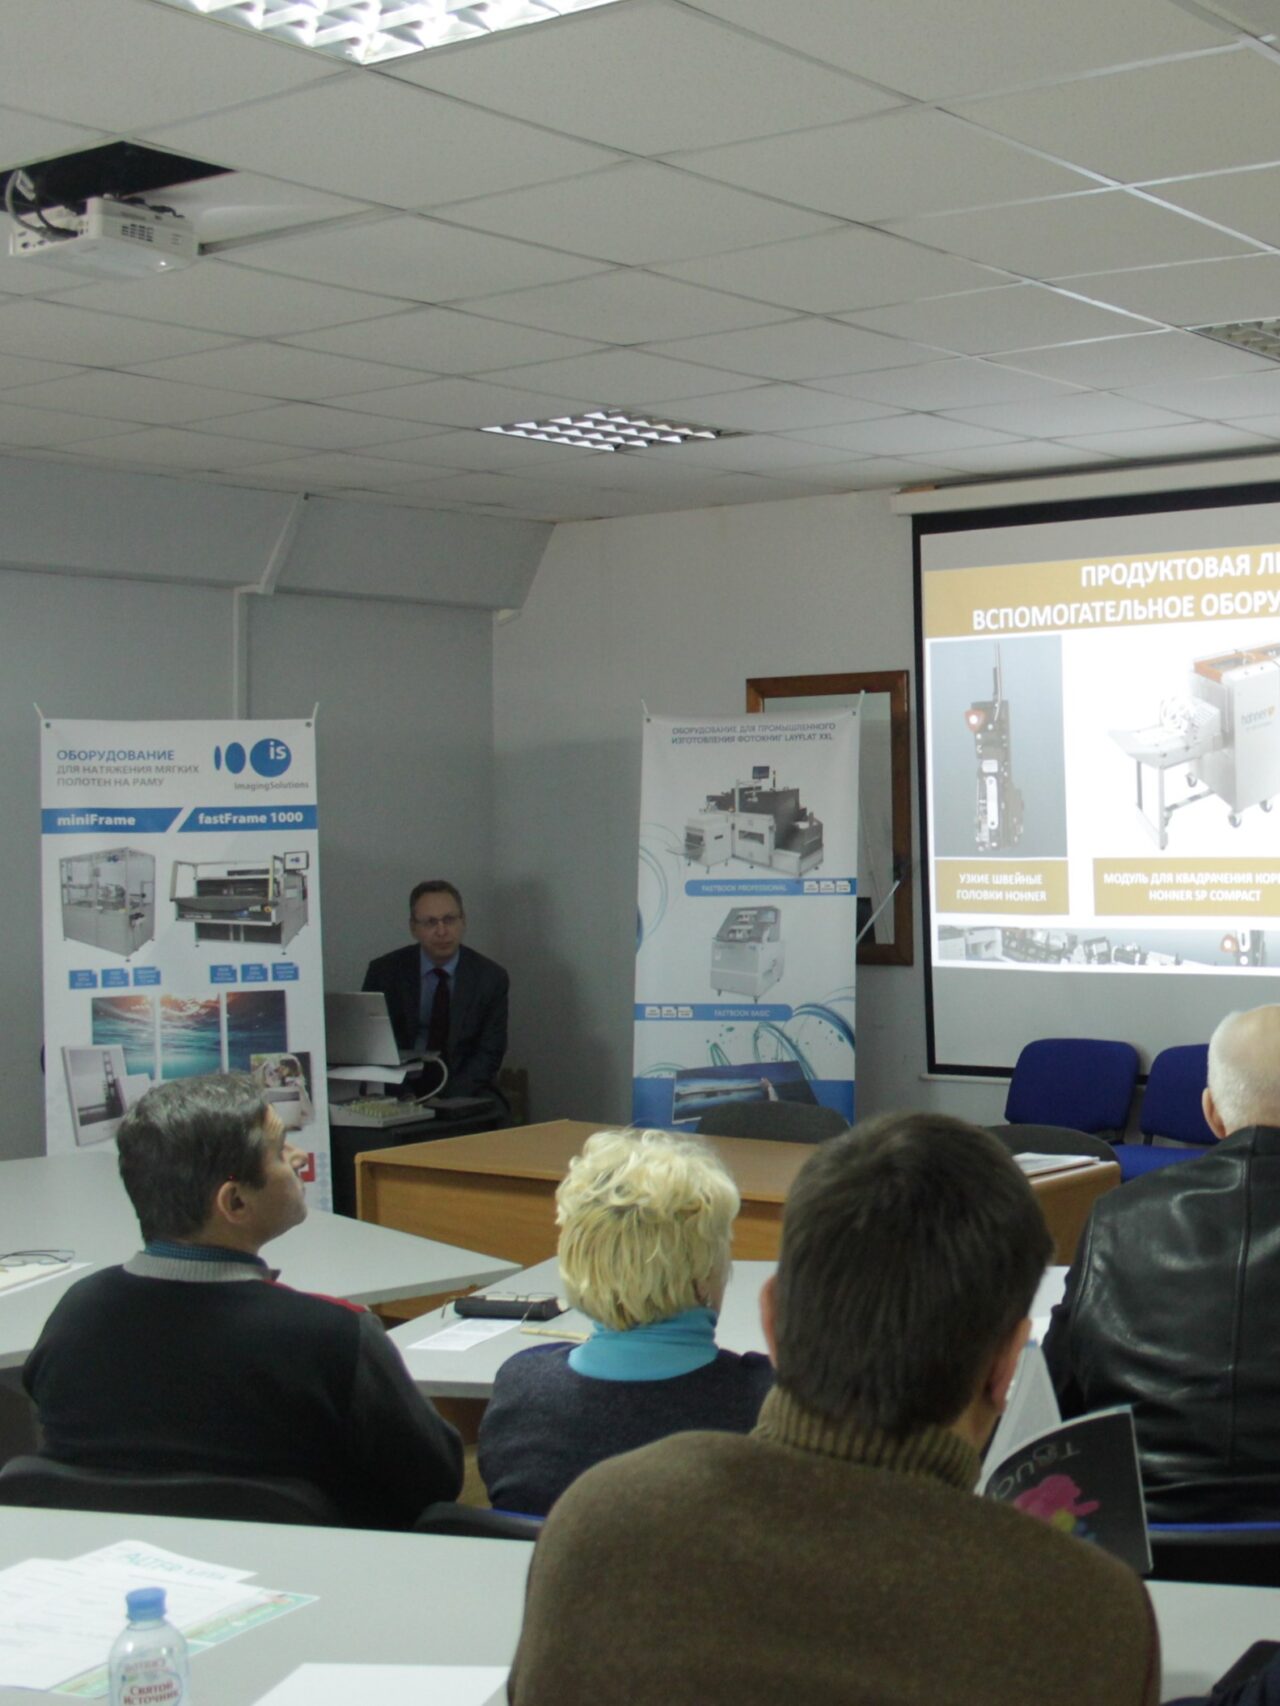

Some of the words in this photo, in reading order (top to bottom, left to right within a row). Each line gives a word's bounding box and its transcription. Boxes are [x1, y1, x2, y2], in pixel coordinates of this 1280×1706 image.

[1081, 554, 1251, 588] ПРОДУКТОВАЯ
[972, 595, 1195, 630] ВСПОМОГАТЕЛЬНОЕ
[672, 726, 737, 736] ОБОРУДОВАНИЕ
[740, 725, 756, 734] ДЛЯ
[758, 722, 836, 732] ПРОМЫШЛЕННОГО
[672, 735, 735, 745] ИЗГОТОВЛЕНИЯ
[57, 749, 175, 763] ОБОРУДОВАНИЕ
[56, 765, 80, 776] ДЛЯ
[82, 765, 153, 775] НАТЯЖЕНИЯ
[155, 764, 199, 774] МЯГКИХ
[57, 778, 111, 788] ПОЛОТЕН
[114, 778, 131, 787] НА
[134, 777, 165, 787] РАМУ
[57, 814, 136, 826] miniFrame
[198, 813, 267, 825] fastFrame
[270, 812, 303, 823] 1000
[959, 873, 989, 884] УЗКИЕ
[992, 872, 1042, 885] ШВЕЙНЫЕ
[1104, 873, 1149, 886] МОДУЛЬ
[1151, 873, 1174, 886] ДЛЯ
[1176, 873, 1252, 886] КВАДРАЧЕНИЯ
[956, 889, 1002, 901] ГОЛОВКИ
[1005, 890, 1046, 902] HOHNER
[1149, 889, 1193, 901] HOHNER
[1209, 890, 1262, 901] COMPACT
[992, 1442, 1080, 1500] TOUC
